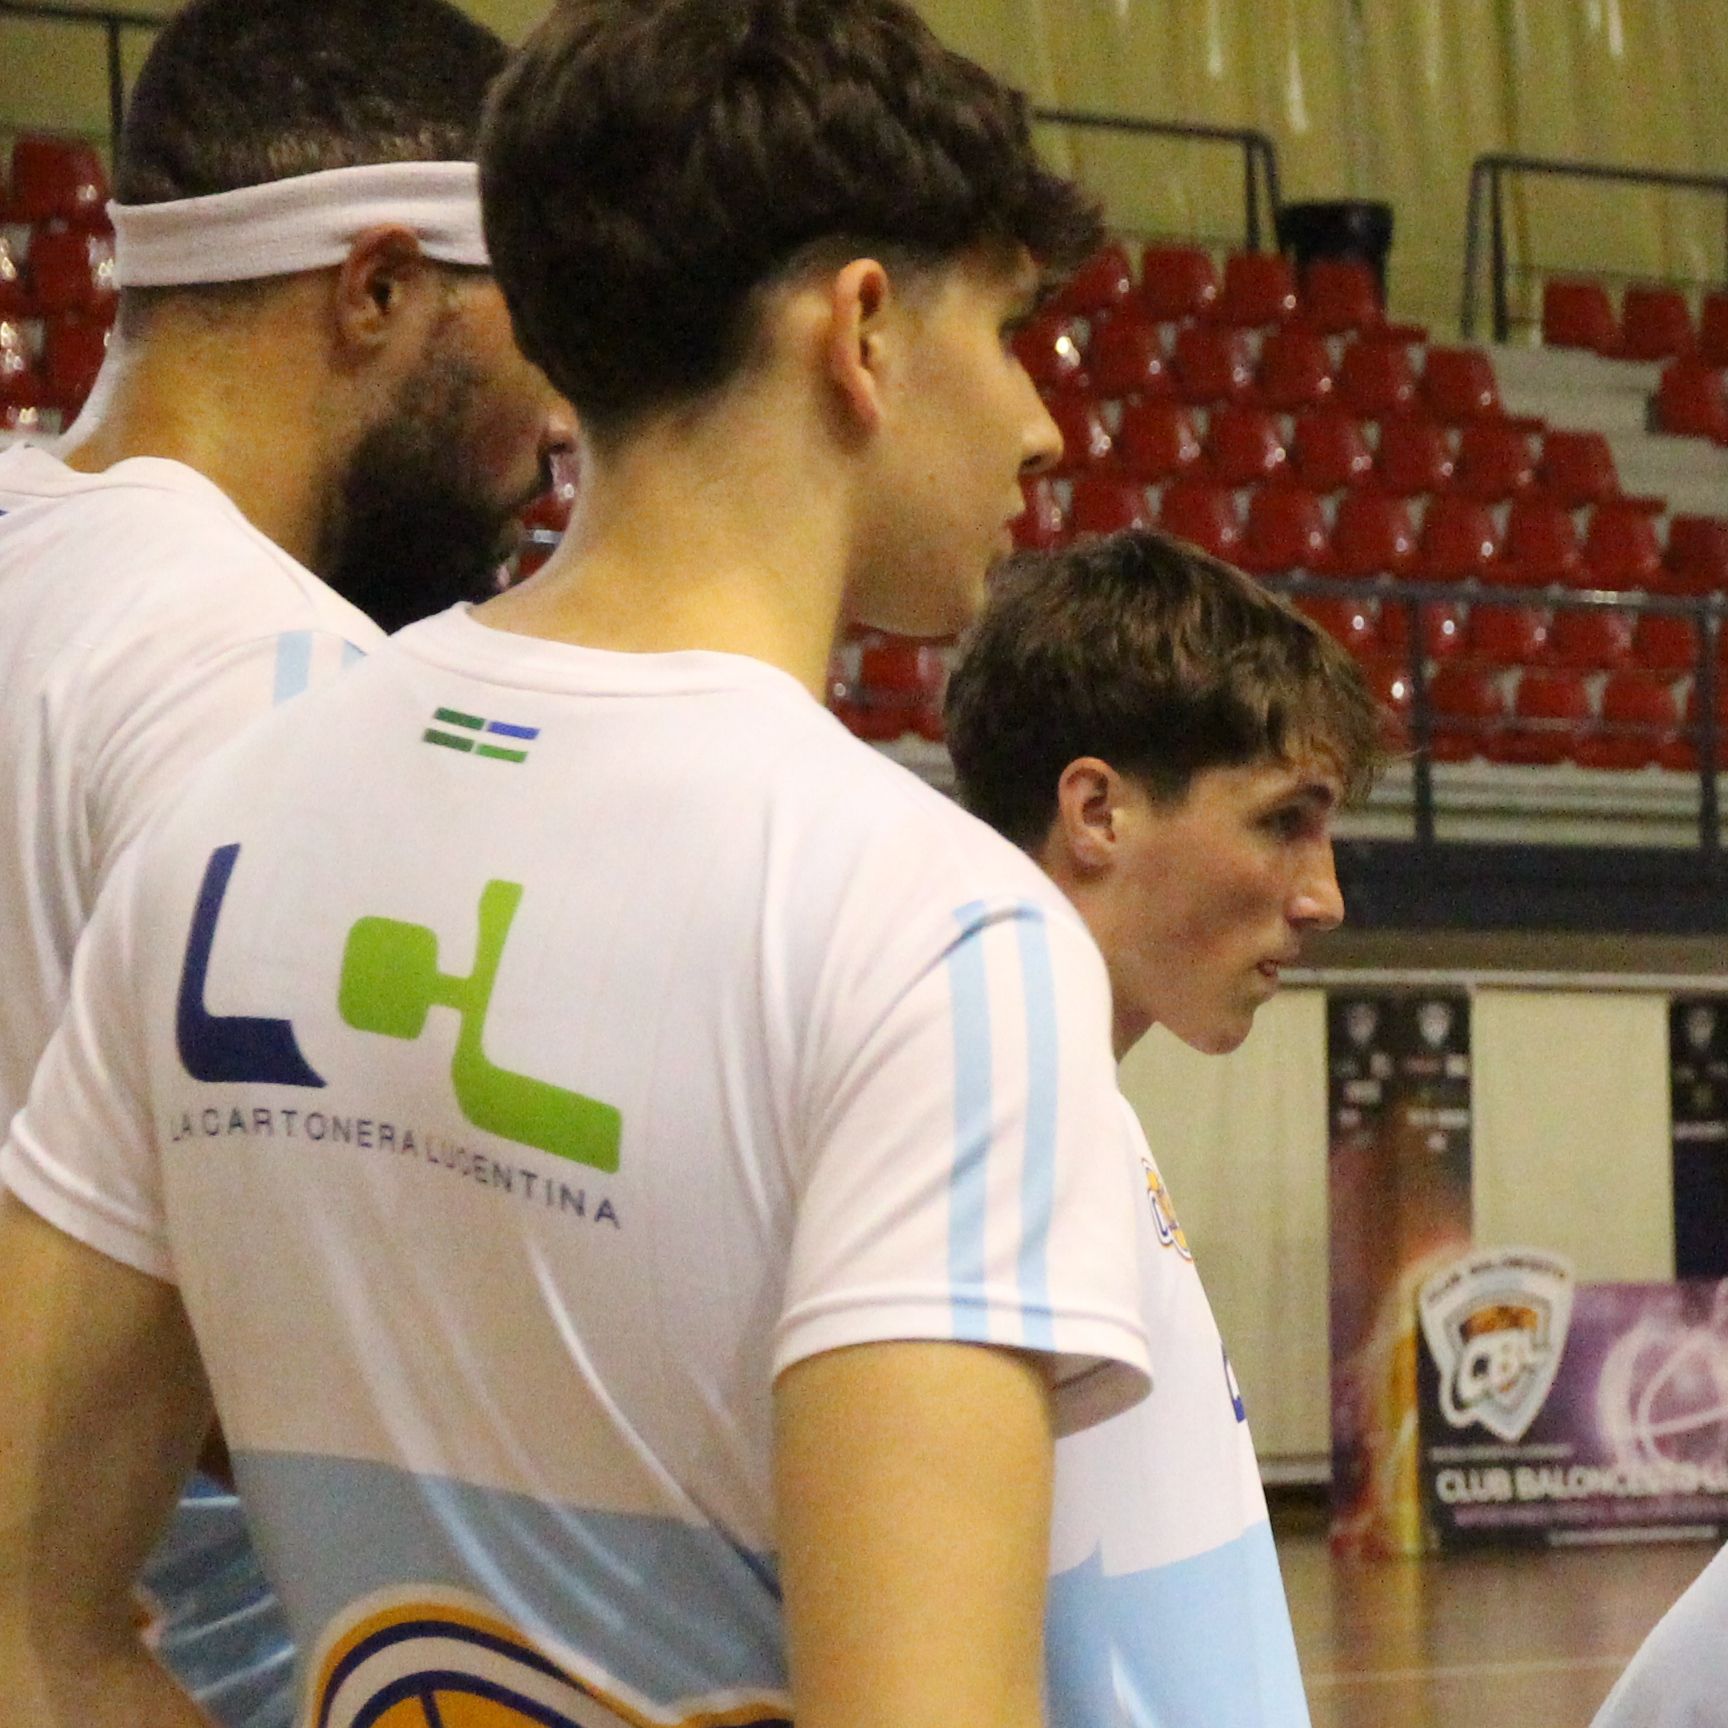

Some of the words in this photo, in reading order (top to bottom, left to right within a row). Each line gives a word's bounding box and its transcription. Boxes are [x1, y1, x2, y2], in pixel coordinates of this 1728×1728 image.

[203, 1107, 420, 1156] CARTONERA
[425, 1135, 622, 1230] LUCENTINA
[1436, 1466, 1513, 1503] CLUB
